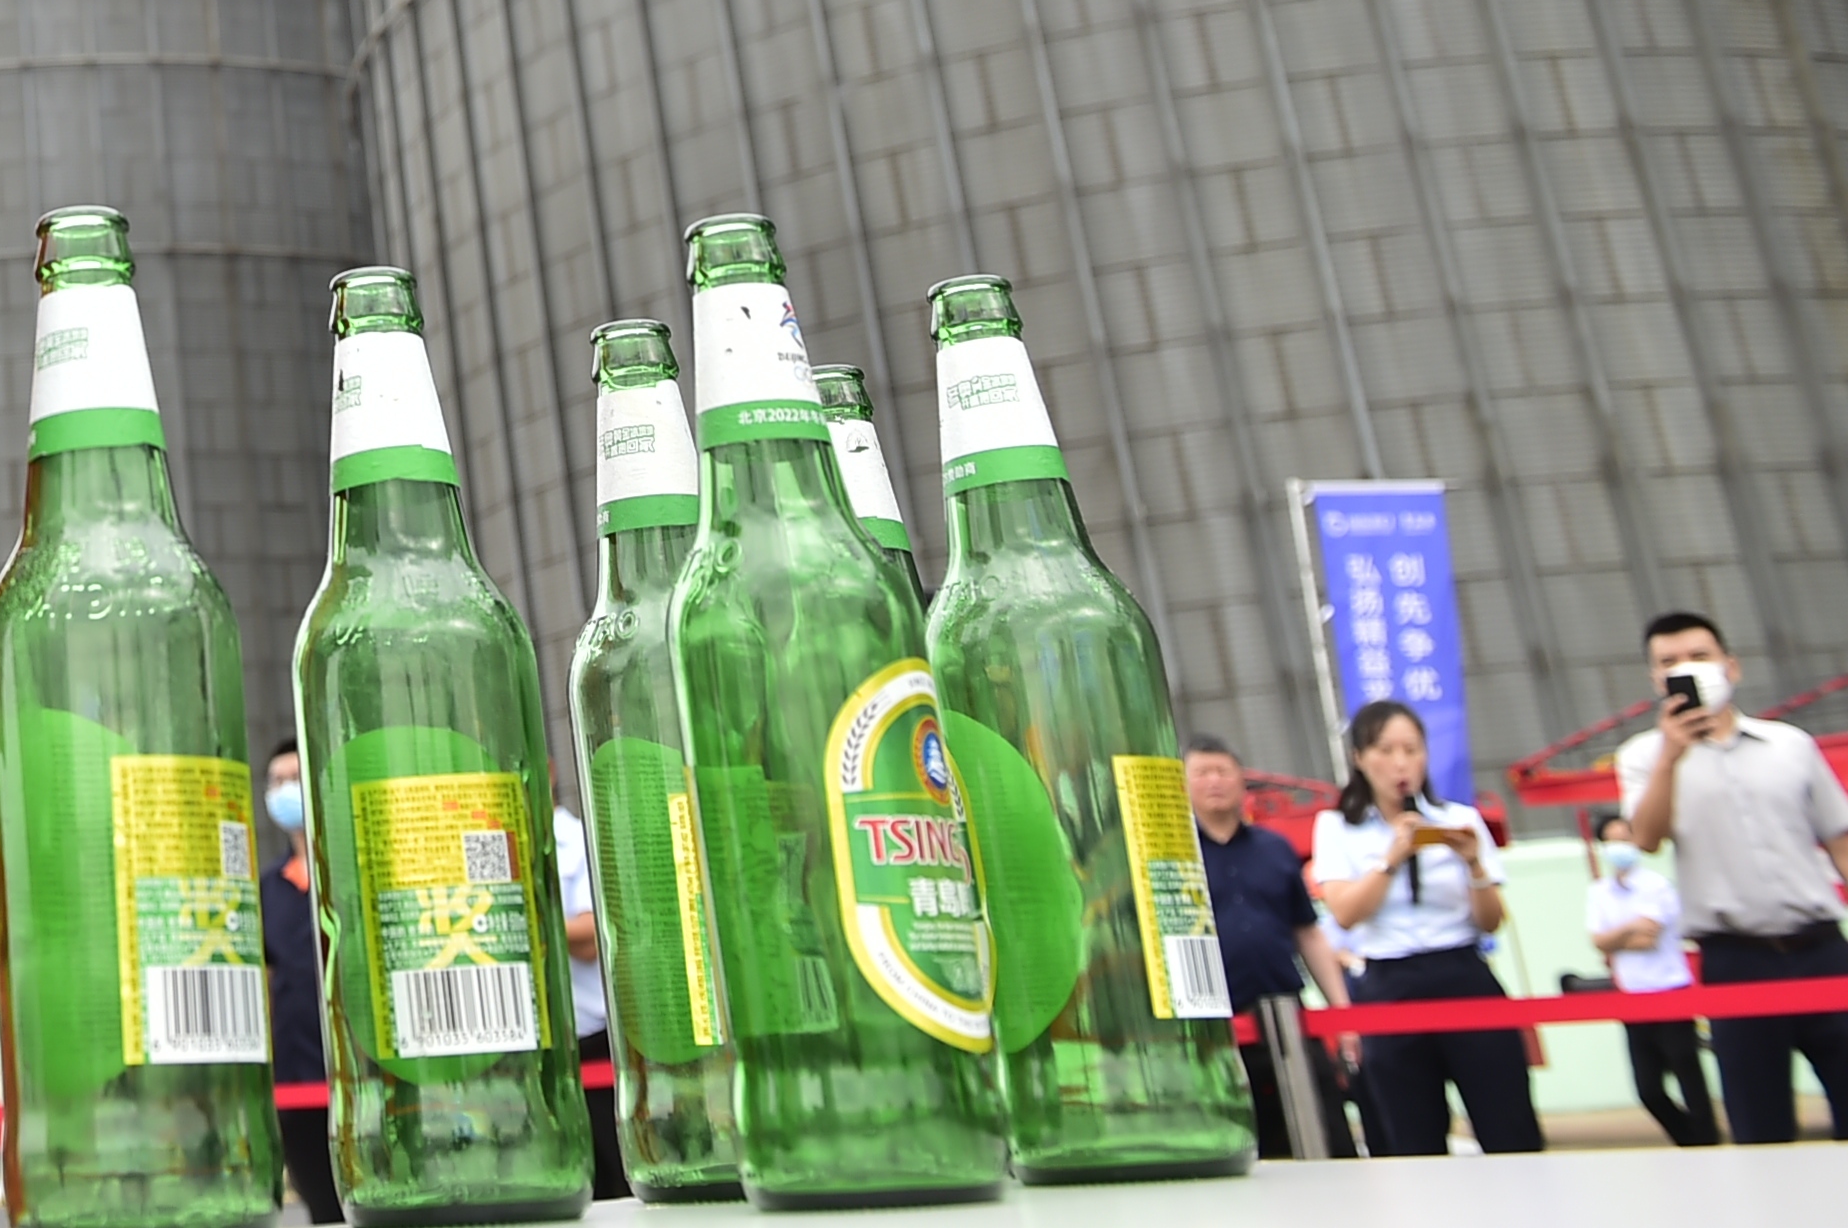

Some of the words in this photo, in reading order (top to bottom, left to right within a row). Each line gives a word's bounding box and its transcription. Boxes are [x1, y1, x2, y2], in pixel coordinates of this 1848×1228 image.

[1388, 551, 1443, 701] 创先争优
[400, 1036, 409, 1050] 6
